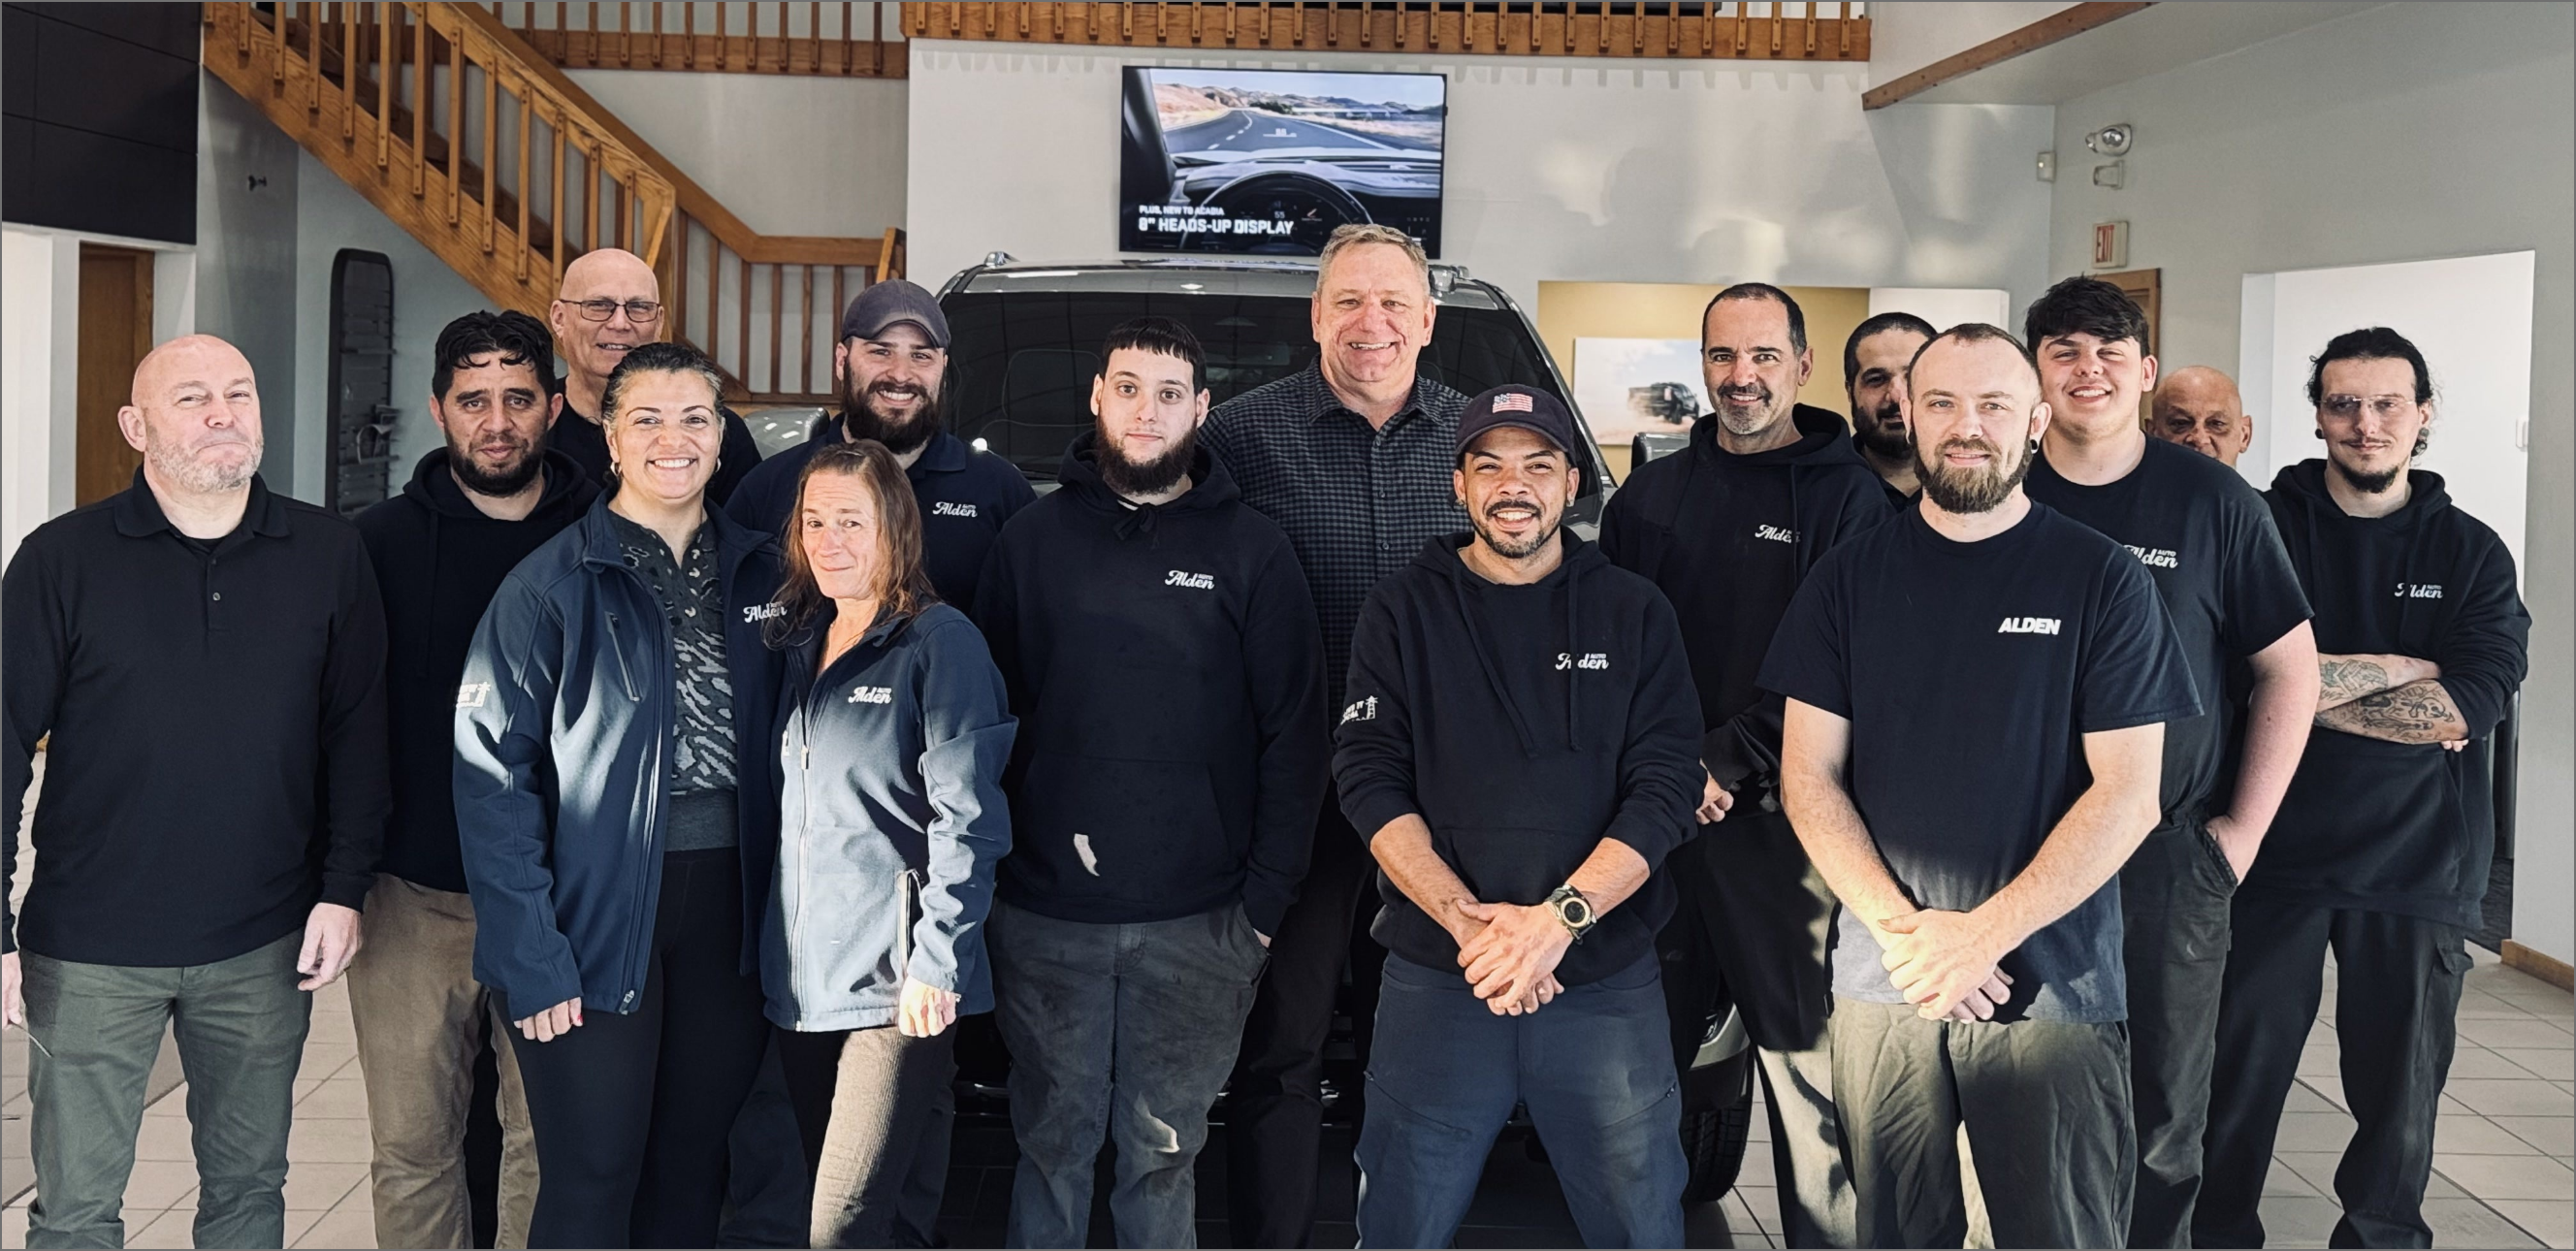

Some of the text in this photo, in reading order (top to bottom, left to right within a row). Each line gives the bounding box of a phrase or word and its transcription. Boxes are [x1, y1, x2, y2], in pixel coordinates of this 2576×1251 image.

[1139, 205, 1162, 215] PLUS,
[1163, 206, 1182, 214] NEW
[1194, 207, 1224, 215] ACADIA
[1139, 217, 1294, 235] 8" HEADS-UP DISPLAY
[2096, 224, 2113, 263] EXIT
[932, 500, 978, 518] Alden
[1755, 524, 1801, 543] Alde
[2157, 549, 2176, 558] AUTO
[1164, 569, 1215, 591] Alden
[1998, 617, 2062, 635] ALDEN
[1555, 652, 1610, 670] Aden
[848, 686, 892, 705] Alden
